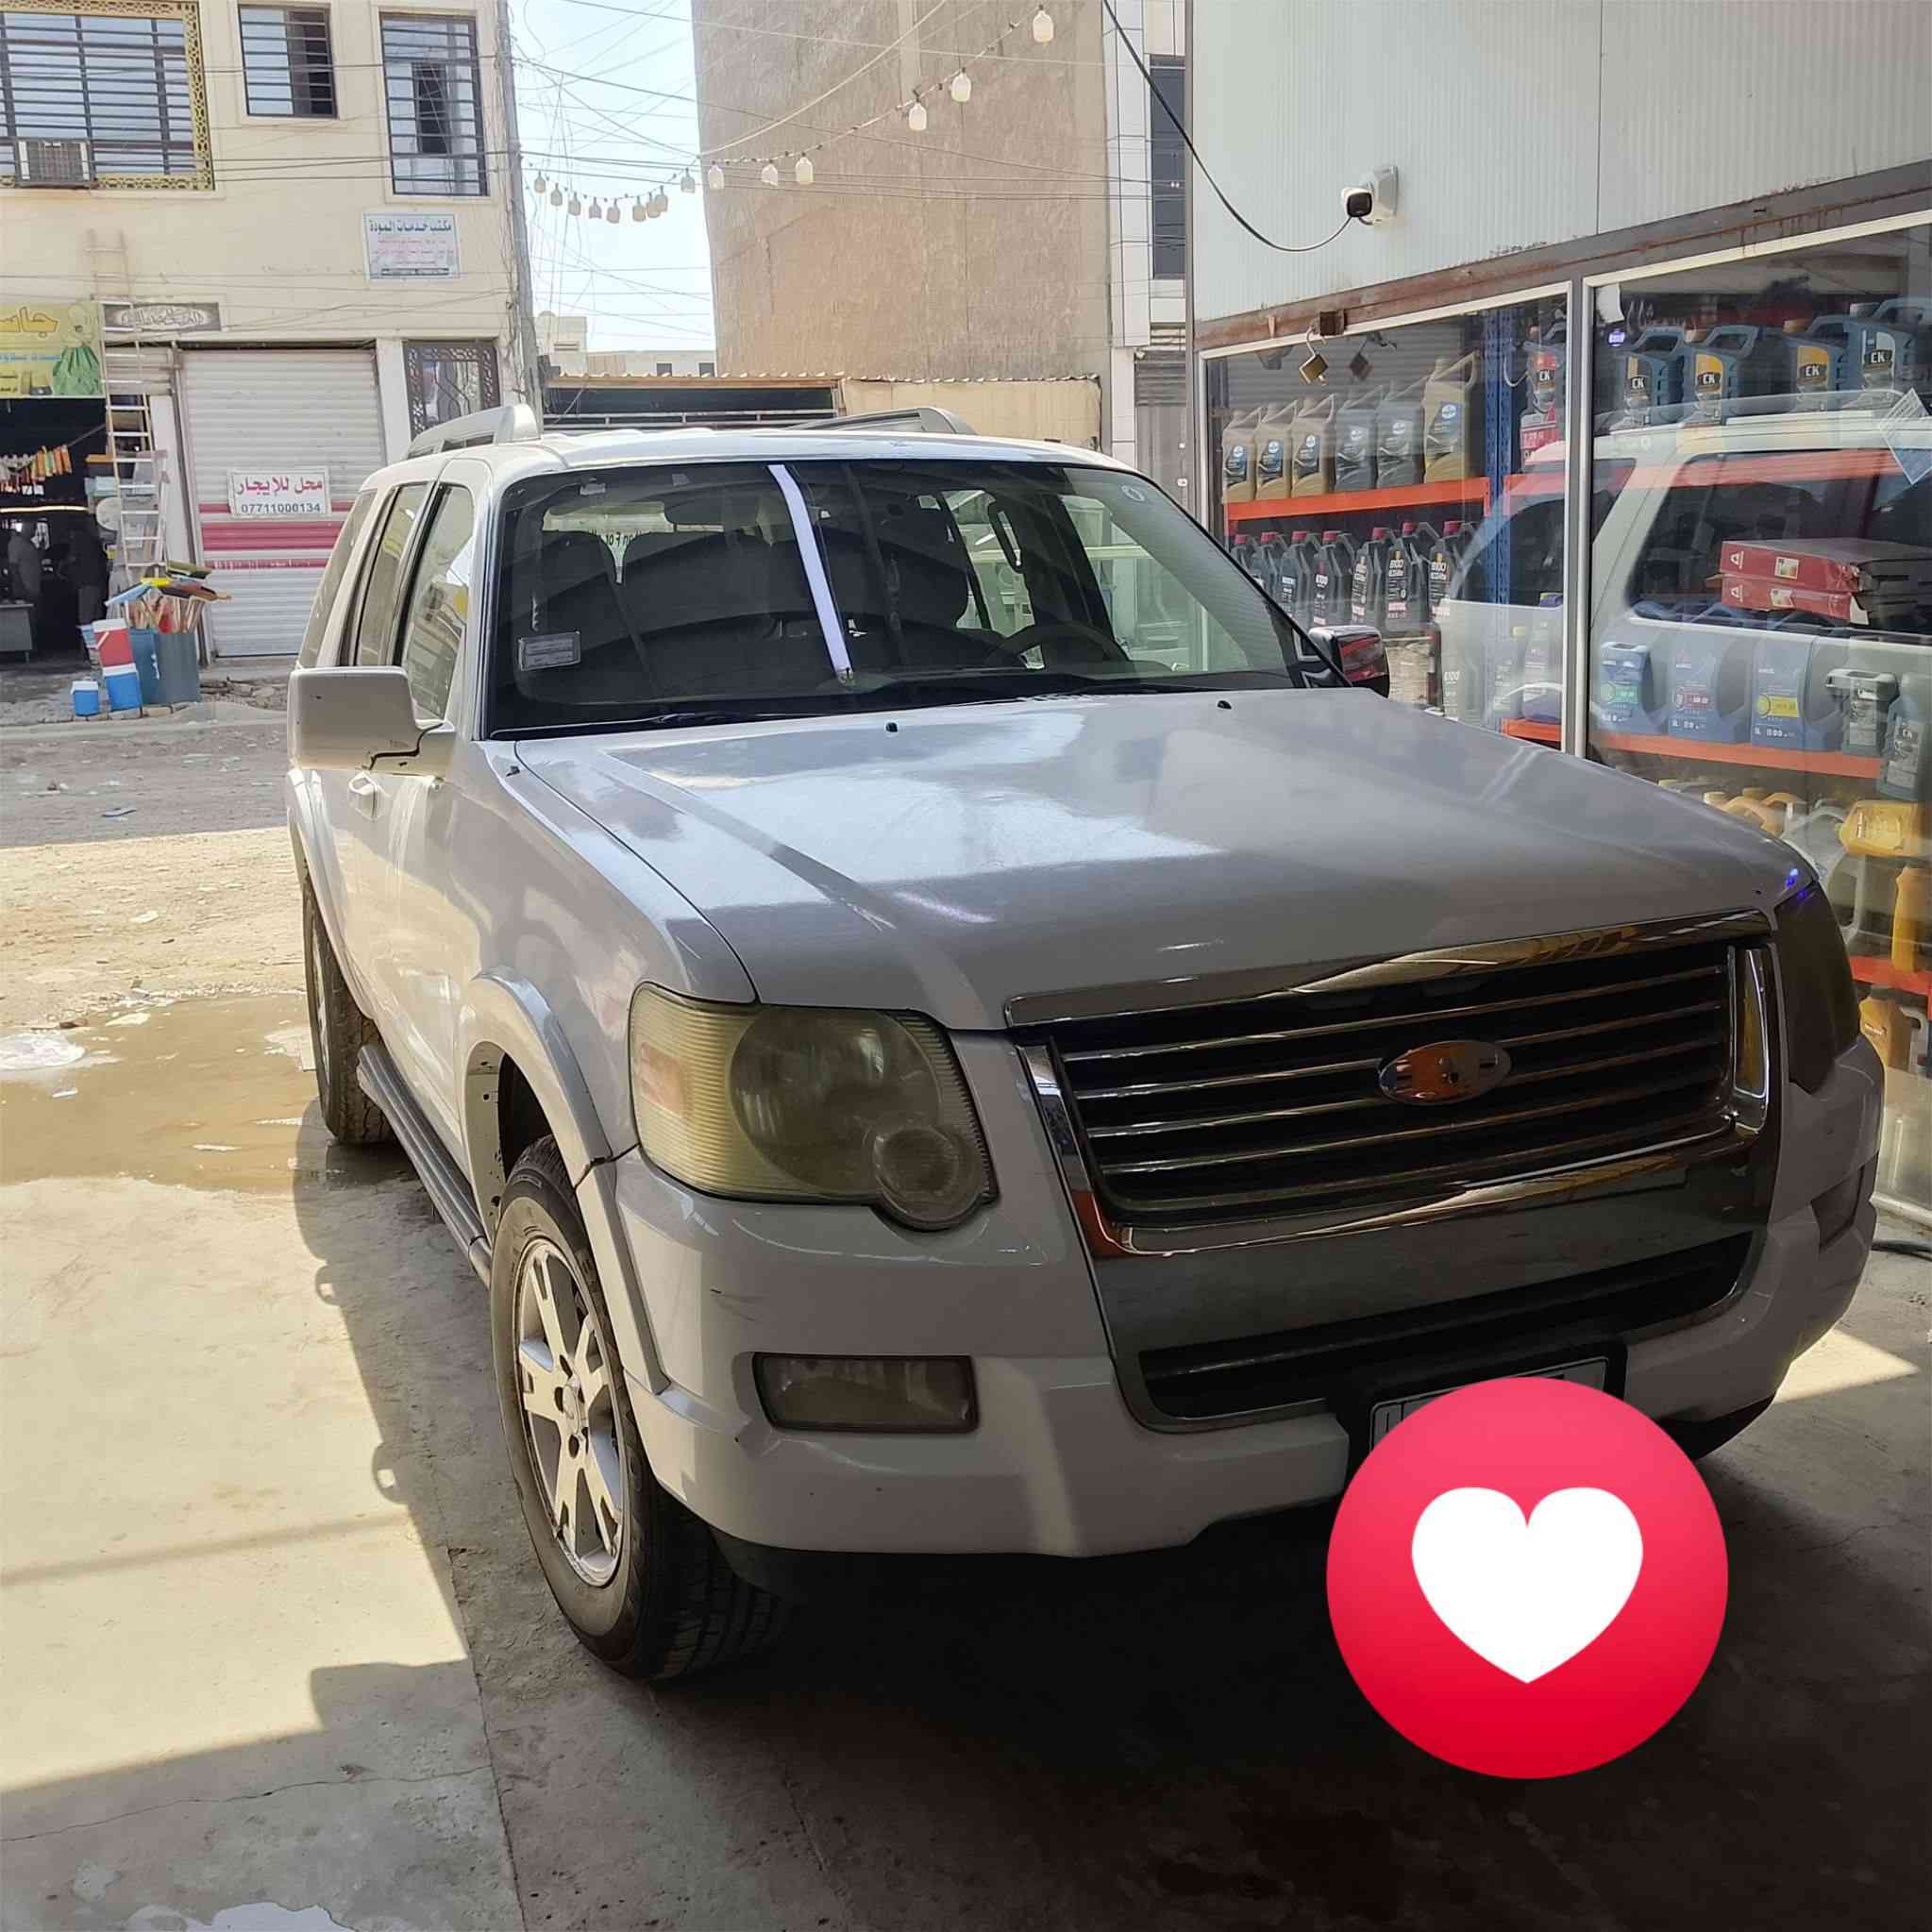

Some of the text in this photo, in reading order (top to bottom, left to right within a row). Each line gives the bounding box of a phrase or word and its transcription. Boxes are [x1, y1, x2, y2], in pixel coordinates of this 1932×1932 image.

[236, 476, 323, 496] محل للإيجار
[241, 503, 321, 513] 07711000134
